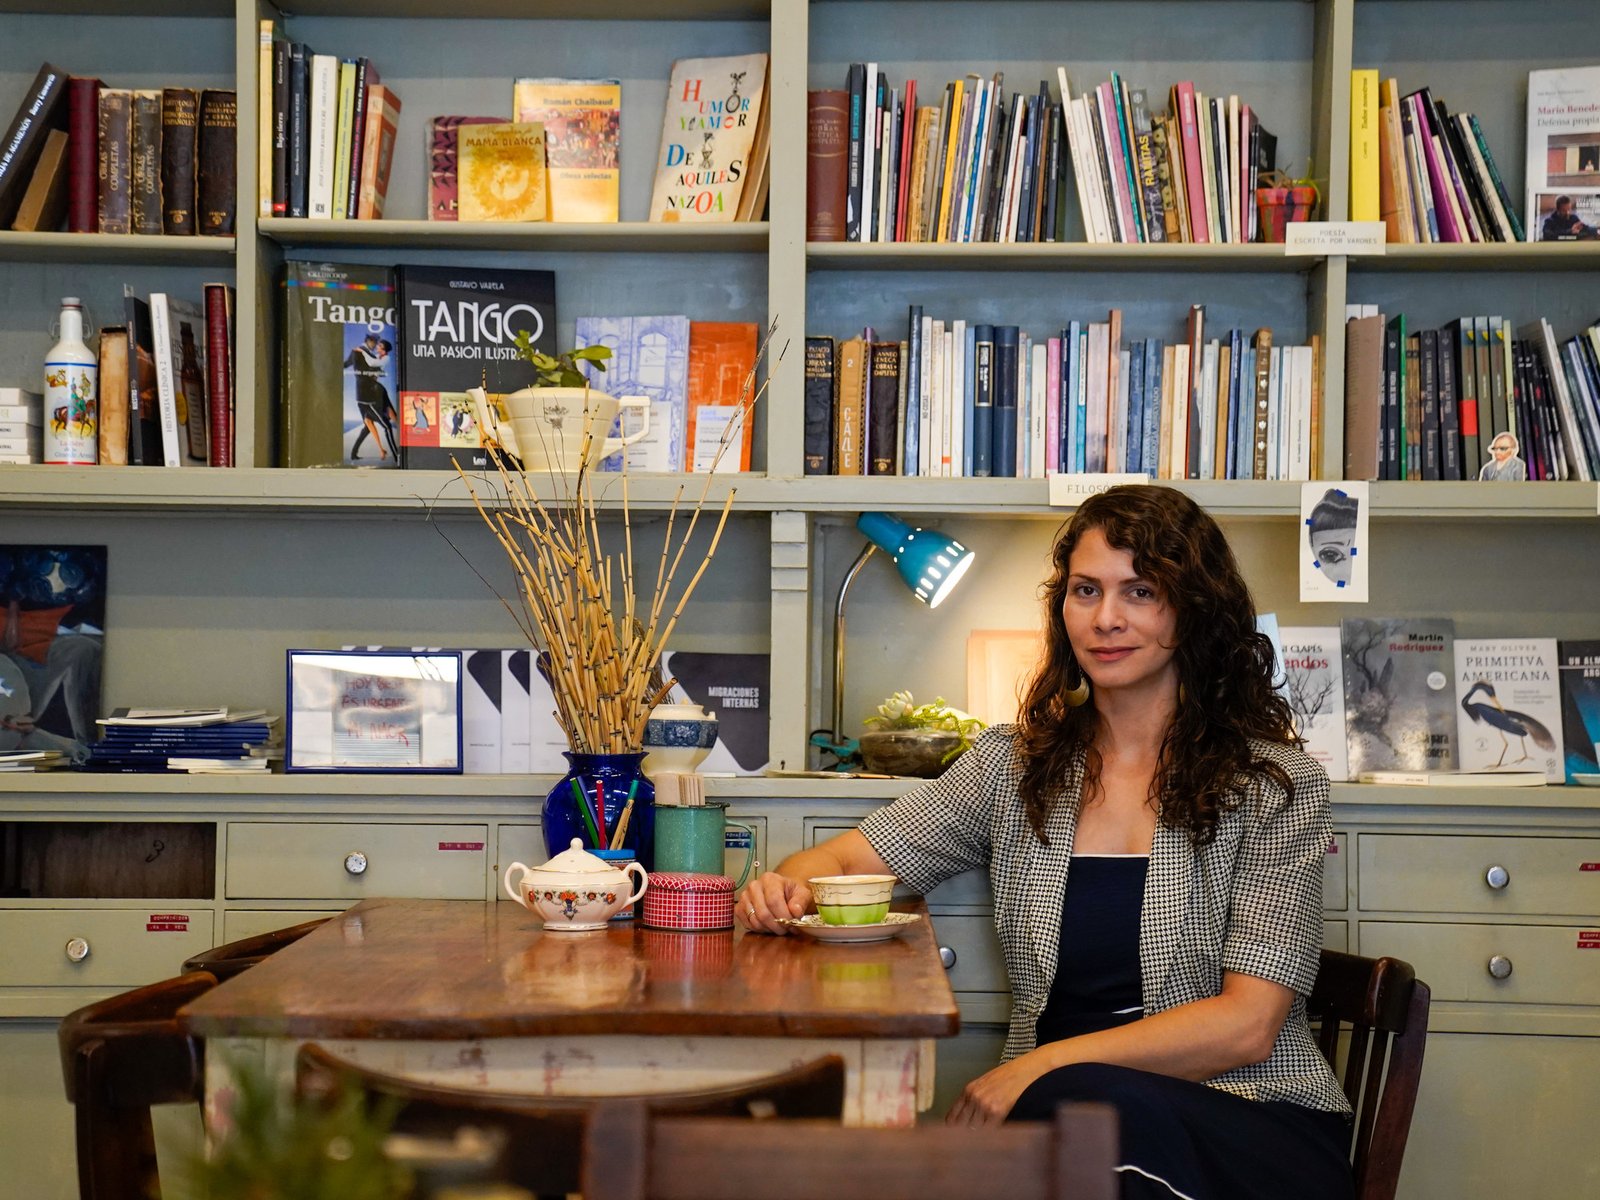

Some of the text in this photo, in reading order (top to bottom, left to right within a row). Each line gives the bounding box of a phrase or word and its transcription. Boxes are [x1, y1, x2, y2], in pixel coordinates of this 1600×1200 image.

[682, 80, 750, 113] HUMOR
[1537, 106, 1565, 115] Mario
[1537, 116, 1600, 127] Defensa propia
[666, 144, 695, 167] DE
[1139, 135, 1155, 186] RAMITAS
[110, 141, 119, 191] COMPLETAS
[146, 144, 154, 194] COMPLETAS
[675, 160, 743, 188] AQUILES
[666, 191, 724, 214] NAZOA
[449, 281, 505, 290] GUSTAVO VARELA
[308, 295, 396, 333] Tango
[411, 299, 544, 344] TANGO
[412, 344, 436, 358] UNA
[485, 346, 543, 361] ILUSTR
[847, 359, 853, 368] 2
[160, 367, 169, 394] CLÍNICA
[162, 395, 173, 433] HISTORIA
[1067, 483, 1110, 494] FILOSO
[1290, 643, 1322, 653] CLAPÉS
[1285, 656, 1328, 669] endos
[1466, 656, 1544, 667] PRIMITIVA
[1584, 656, 1600, 666] ALM
[1462, 671, 1550, 682] AMERICANA
[708, 686, 759, 697] MIGRACIONES
[722, 698, 759, 708] INTERNAS
